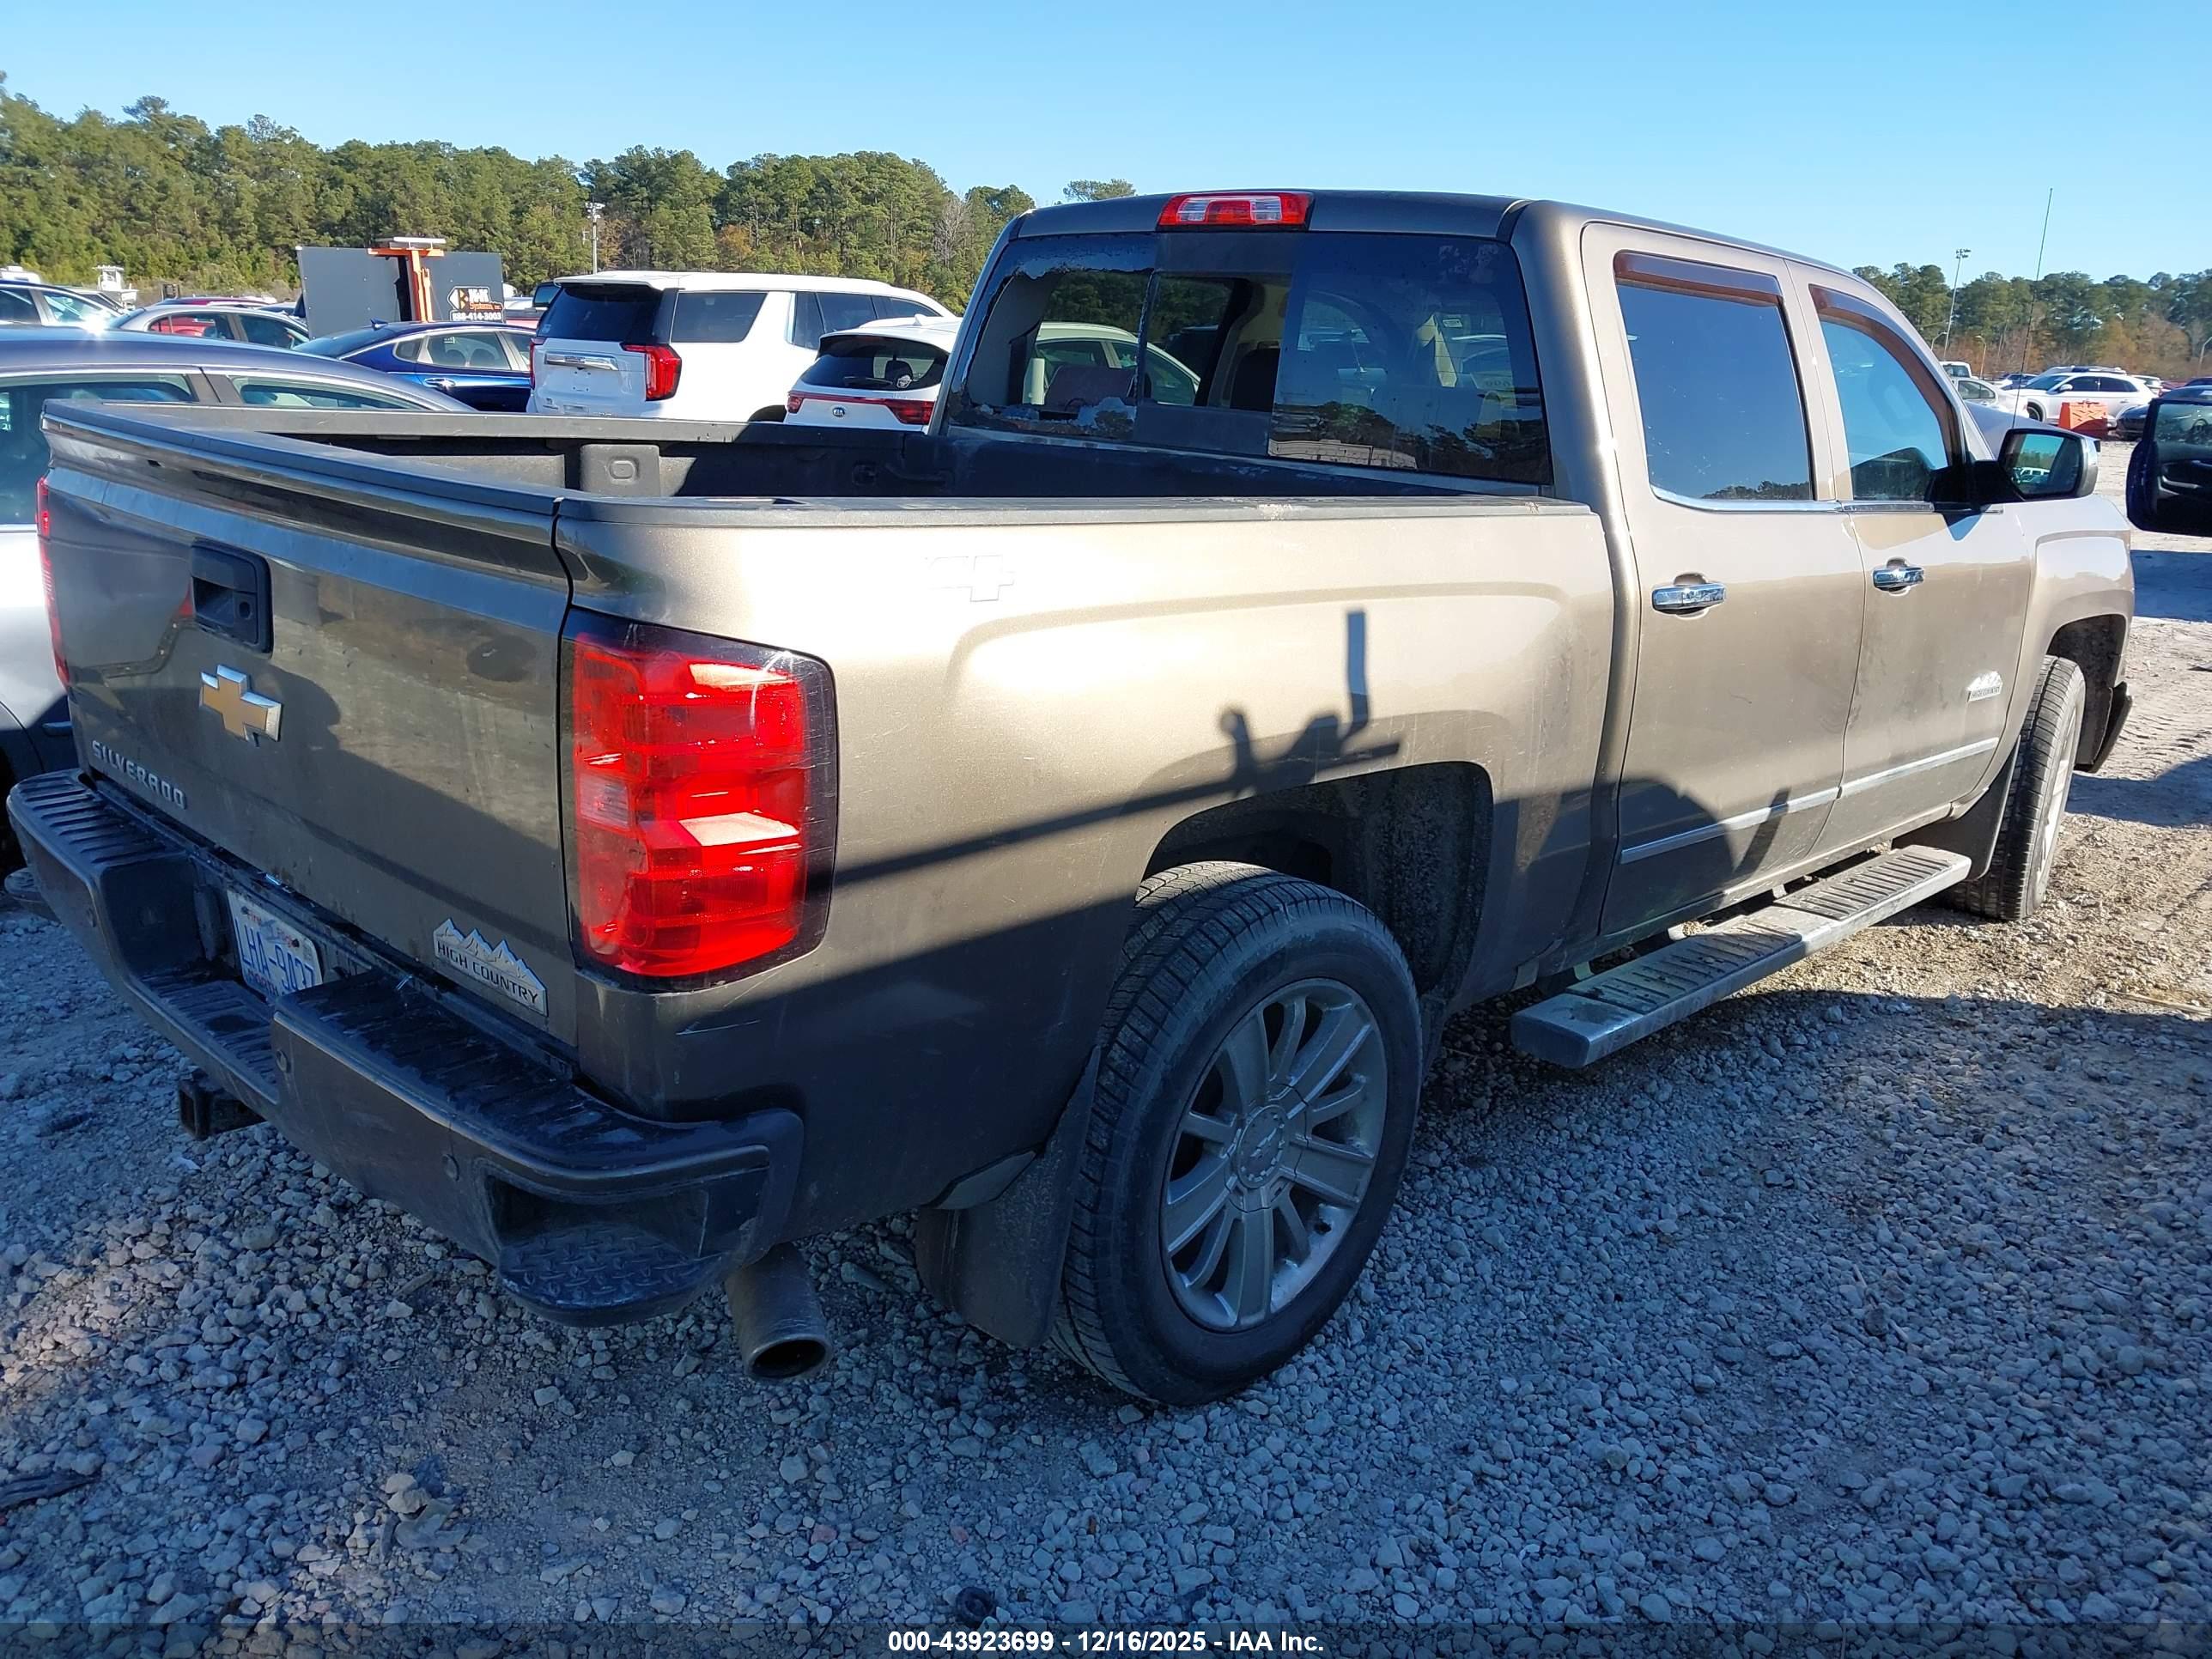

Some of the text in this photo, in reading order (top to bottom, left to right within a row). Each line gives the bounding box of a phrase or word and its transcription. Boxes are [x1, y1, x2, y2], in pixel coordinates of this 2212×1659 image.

[92, 739, 186, 809] SILVERADO
[437, 940, 538, 1003] HIGH COUNTRY
